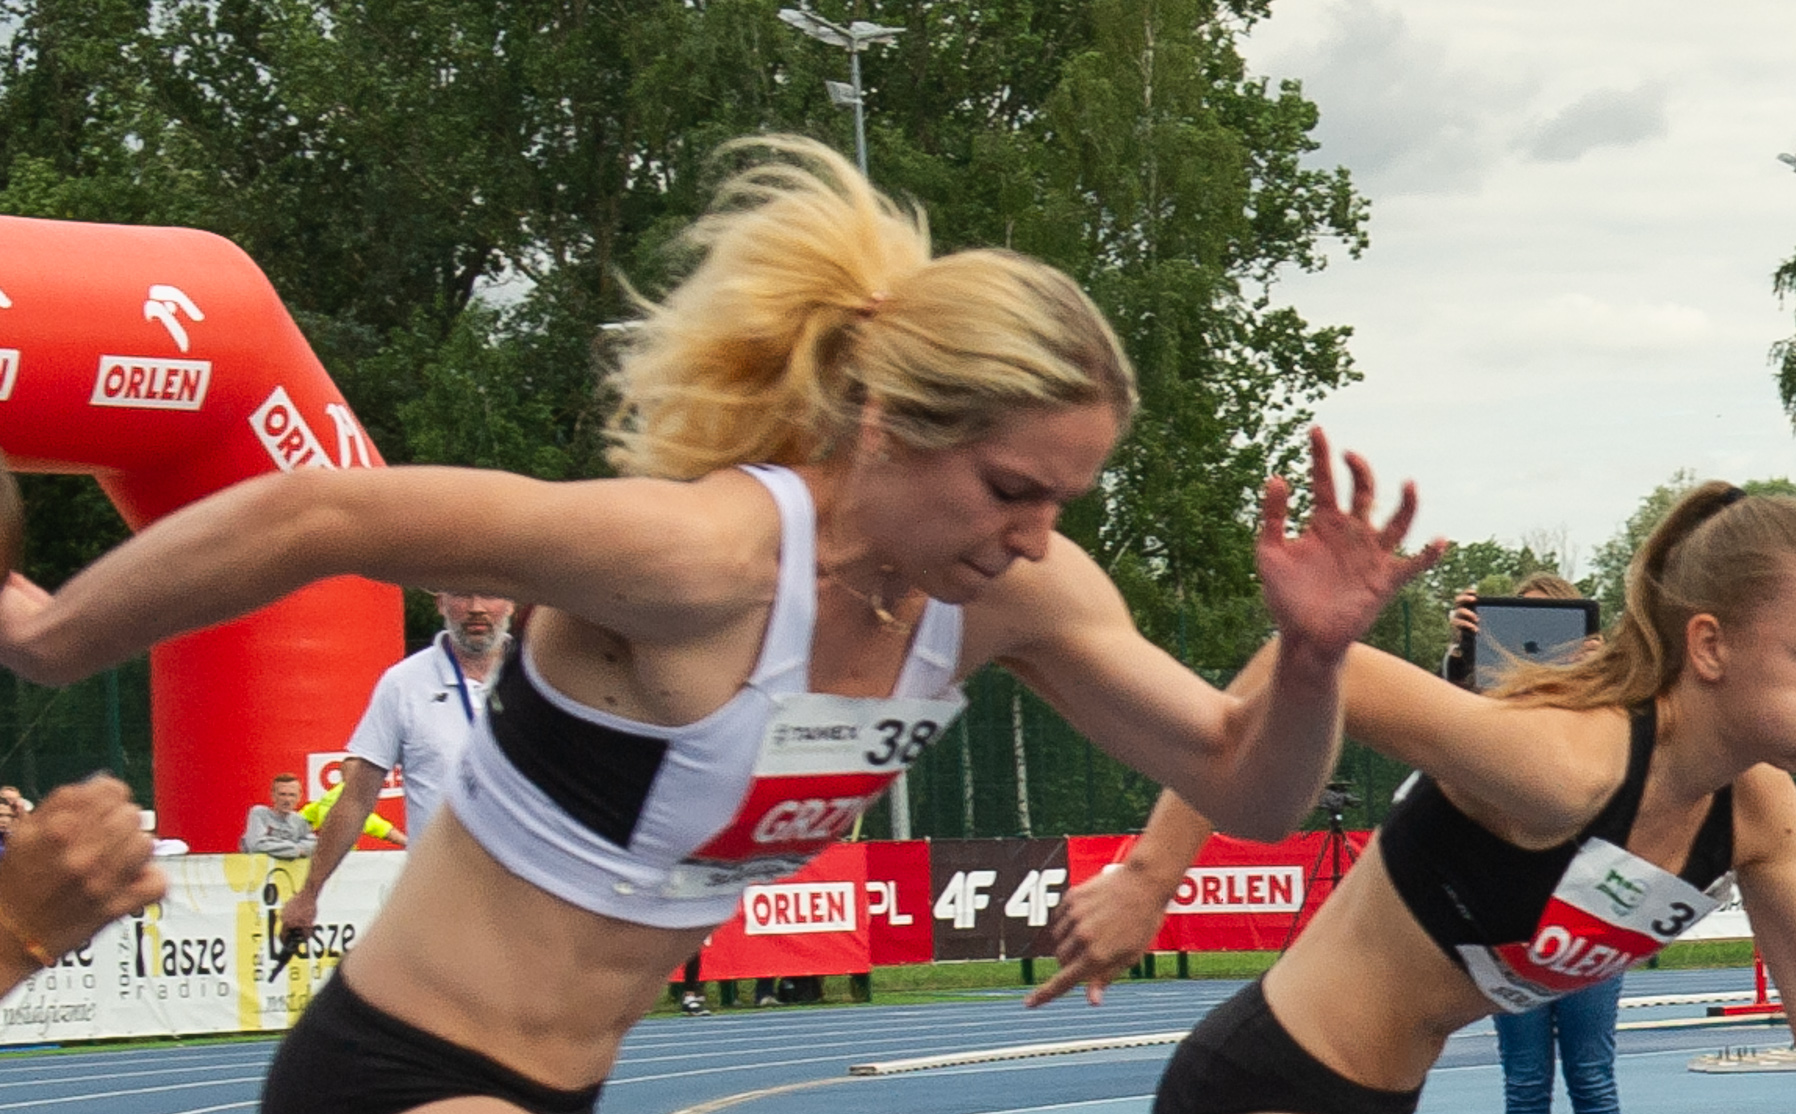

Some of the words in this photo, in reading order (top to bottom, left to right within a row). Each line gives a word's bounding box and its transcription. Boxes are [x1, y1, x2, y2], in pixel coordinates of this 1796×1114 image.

[103, 364, 201, 401] ORLEN
[263, 404, 329, 468] ORL
[933, 871, 996, 928] 4F
[1174, 875, 1292, 906] ORLEN
[753, 891, 846, 926] ORLEN
[26, 973, 96, 992] adio
[136, 980, 230, 999] radio
